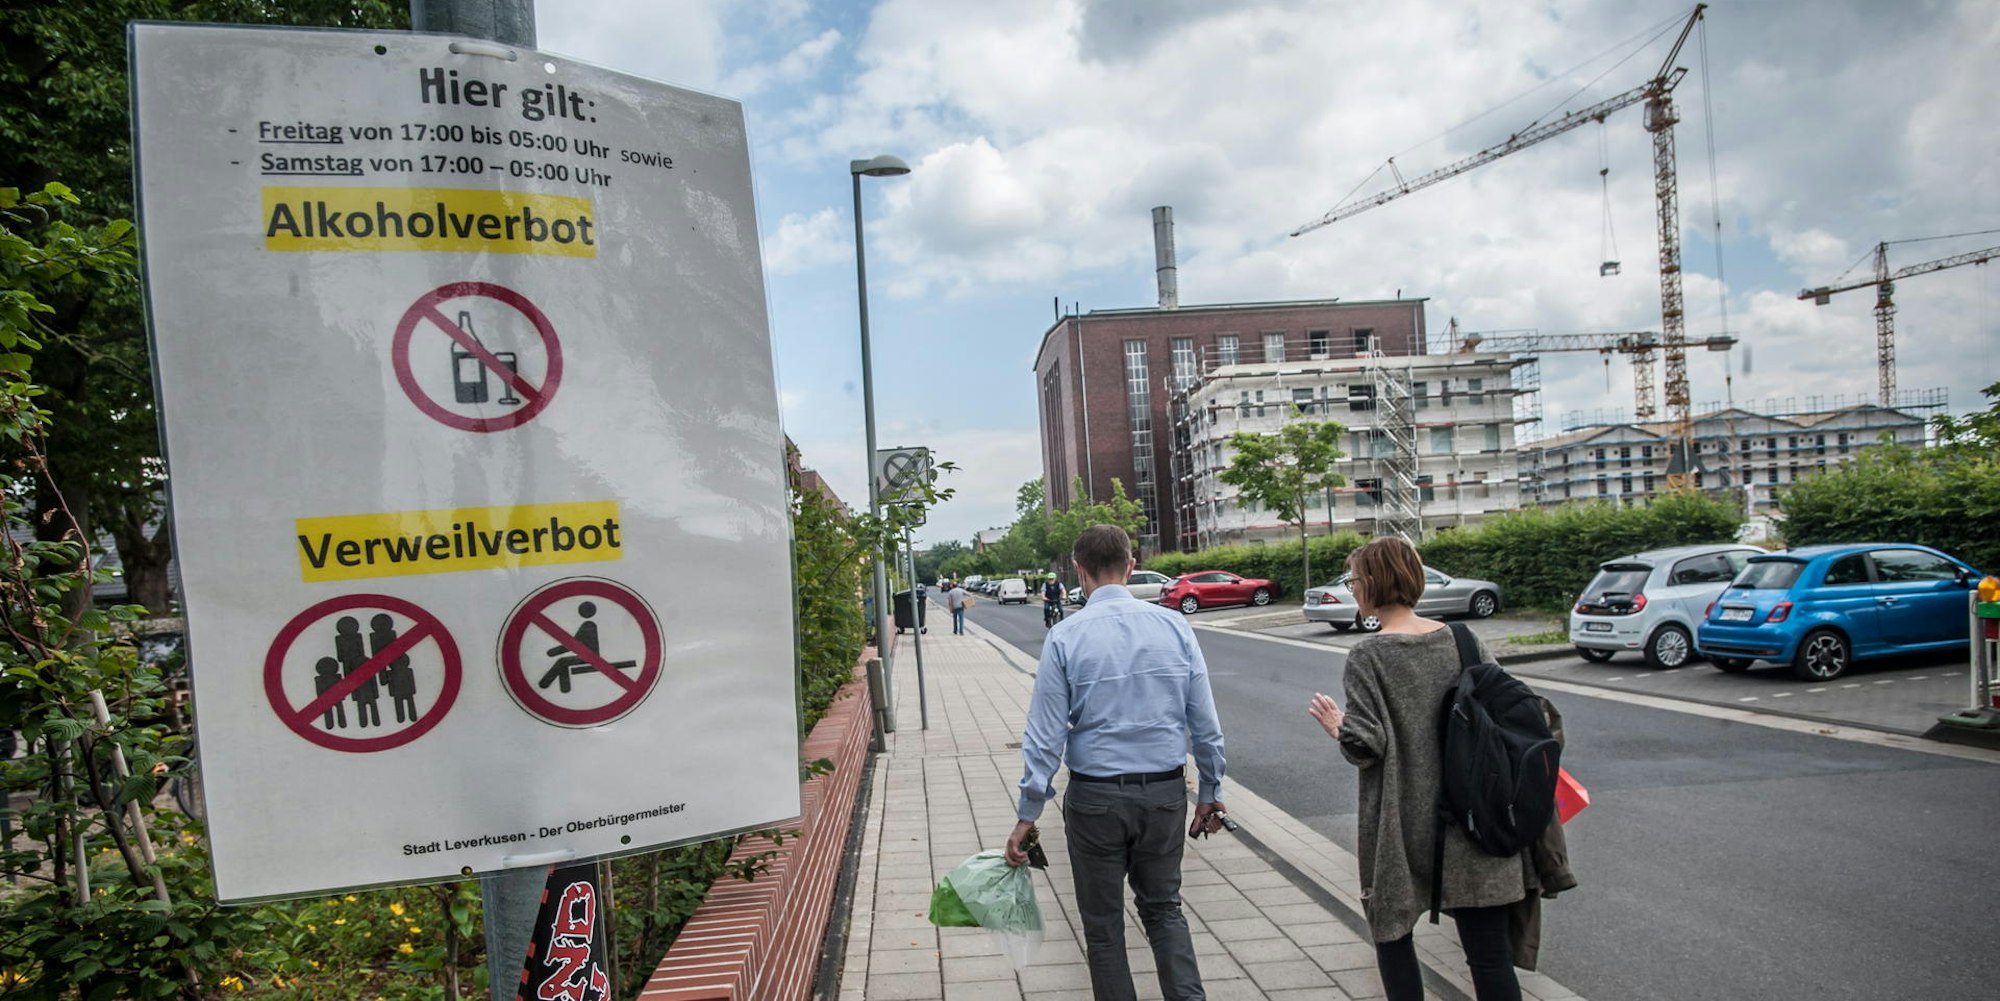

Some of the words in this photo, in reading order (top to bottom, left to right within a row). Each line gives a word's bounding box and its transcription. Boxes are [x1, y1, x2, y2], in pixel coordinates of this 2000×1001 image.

[419, 67, 507, 108] Hier
[521, 84, 597, 123] gilt:
[259, 121, 344, 144] Freitag
[349, 126, 393, 141] von
[401, 124, 464, 142] 17:00
[471, 125, 503, 145] bis
[509, 130, 567, 152] 05:00
[574, 138, 610, 159] Uhr
[621, 149, 673, 169] sowie
[261, 153, 365, 176] Samstag
[369, 157, 413, 172] von
[420, 155, 483, 174] 17:00
[510, 160, 569, 181] 05:00
[575, 166, 612, 187] Uhr
[267, 201, 594, 246] Alkoholverbot
[299, 516, 621, 569] Verweilverbot
[403, 842, 441, 856] Stadt
[445, 831, 526, 851] Leverkusen
[539, 825, 563, 838] Der
[566, 801, 686, 833] Oberbürgermeister
